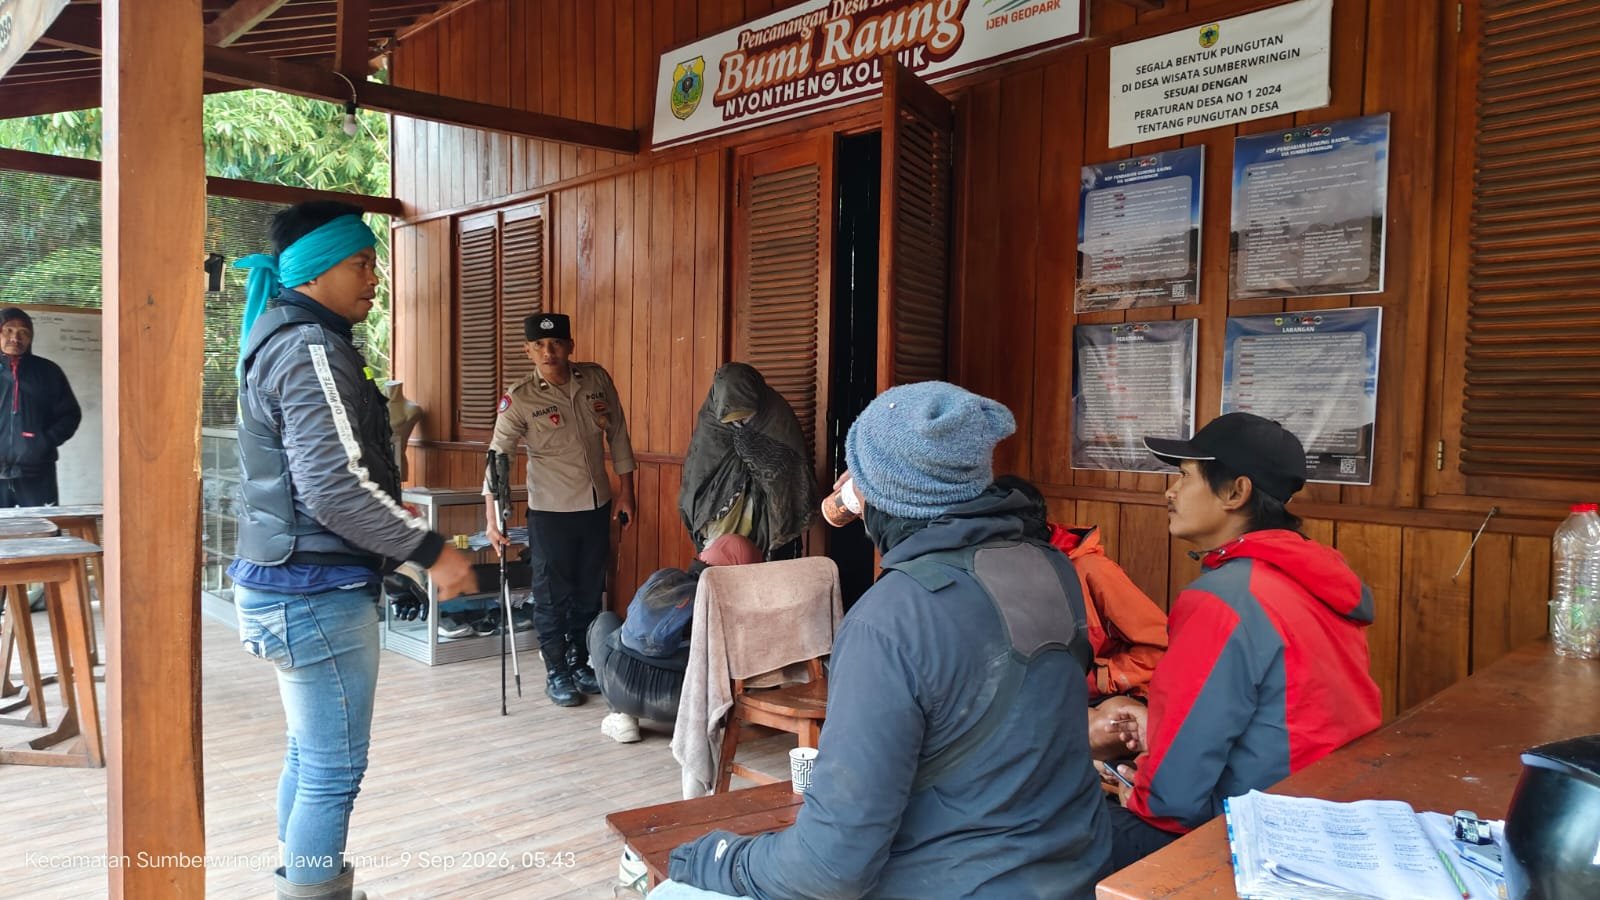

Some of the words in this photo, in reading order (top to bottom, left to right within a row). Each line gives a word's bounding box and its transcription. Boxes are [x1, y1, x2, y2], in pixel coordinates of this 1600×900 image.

[740, 9, 828, 50] Pencanangan
[986, 14, 1009, 31] IJEN
[1011, 0, 1061, 22] GEOPARK
[717, 41, 809, 96] Bumi
[818, 0, 958, 68] Raung
[1135, 59, 1173, 76] SEGALA
[1175, 49, 1218, 67] BENTUK
[1220, 34, 1284, 57] PUNGUTAN
[1121, 82, 1132, 94] DI
[1134, 77, 1159, 92] DESA
[1161, 69, 1201, 85] WISATA
[1202, 47, 1301, 77] SUMBERWRINGIN
[1163, 84, 1199, 100] SESUAI
[1201, 74, 1248, 93] DENGAN
[724, 72, 836, 117] NYONTHENG
[1134, 100, 1194, 120] PERATURAN
[1196, 95, 1224, 109] DESA
[1226, 91, 1243, 104] NO
[1246, 90, 1252, 100] 1
[1255, 83, 1282, 98] 2024
[1137, 117, 1184, 135] TENTANG
[1186, 107, 1248, 126] PUNGUTAN
[1250, 100, 1280, 114] DESA
